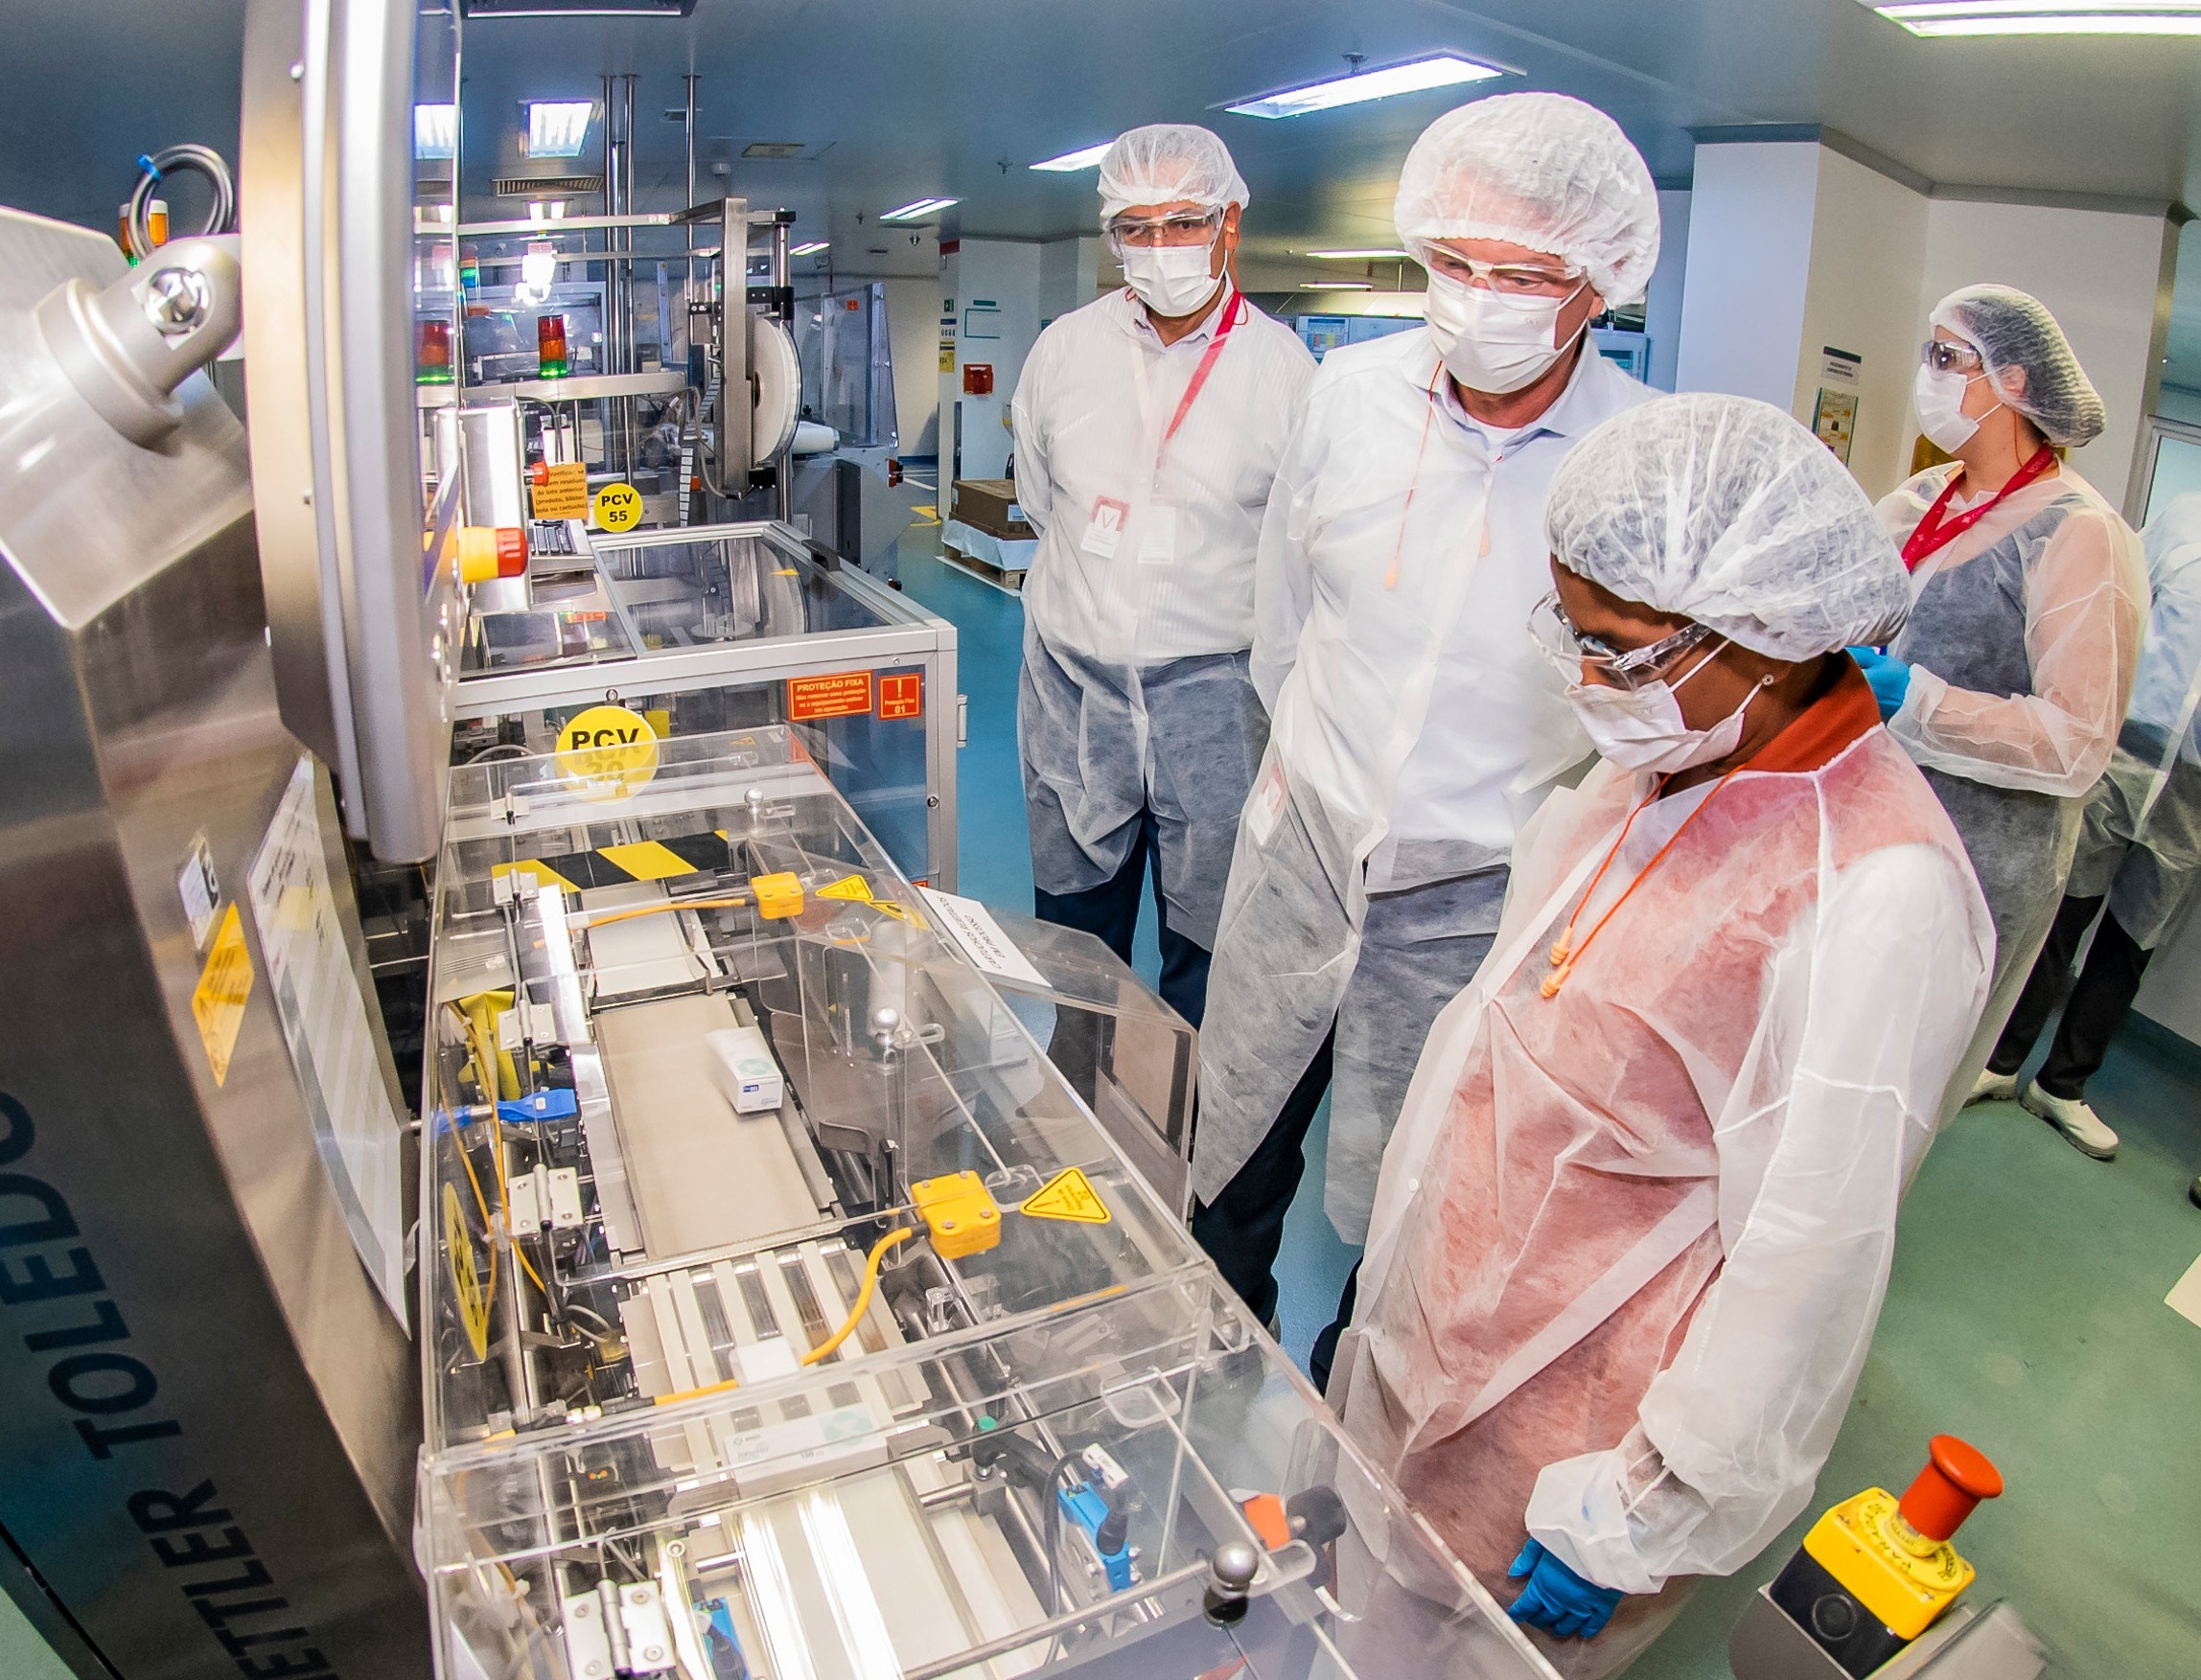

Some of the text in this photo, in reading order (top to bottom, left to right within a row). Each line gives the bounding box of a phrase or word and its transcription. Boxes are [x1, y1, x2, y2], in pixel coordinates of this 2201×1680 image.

[601, 493, 634, 507] PCV
[609, 510, 628, 523] 55
[797, 678, 865, 692] PROTEÇÃO FIXA
[894, 704, 906, 714] 01
[571, 727, 639, 753] PCV
[126, 1478, 341, 1680] ETTLER
